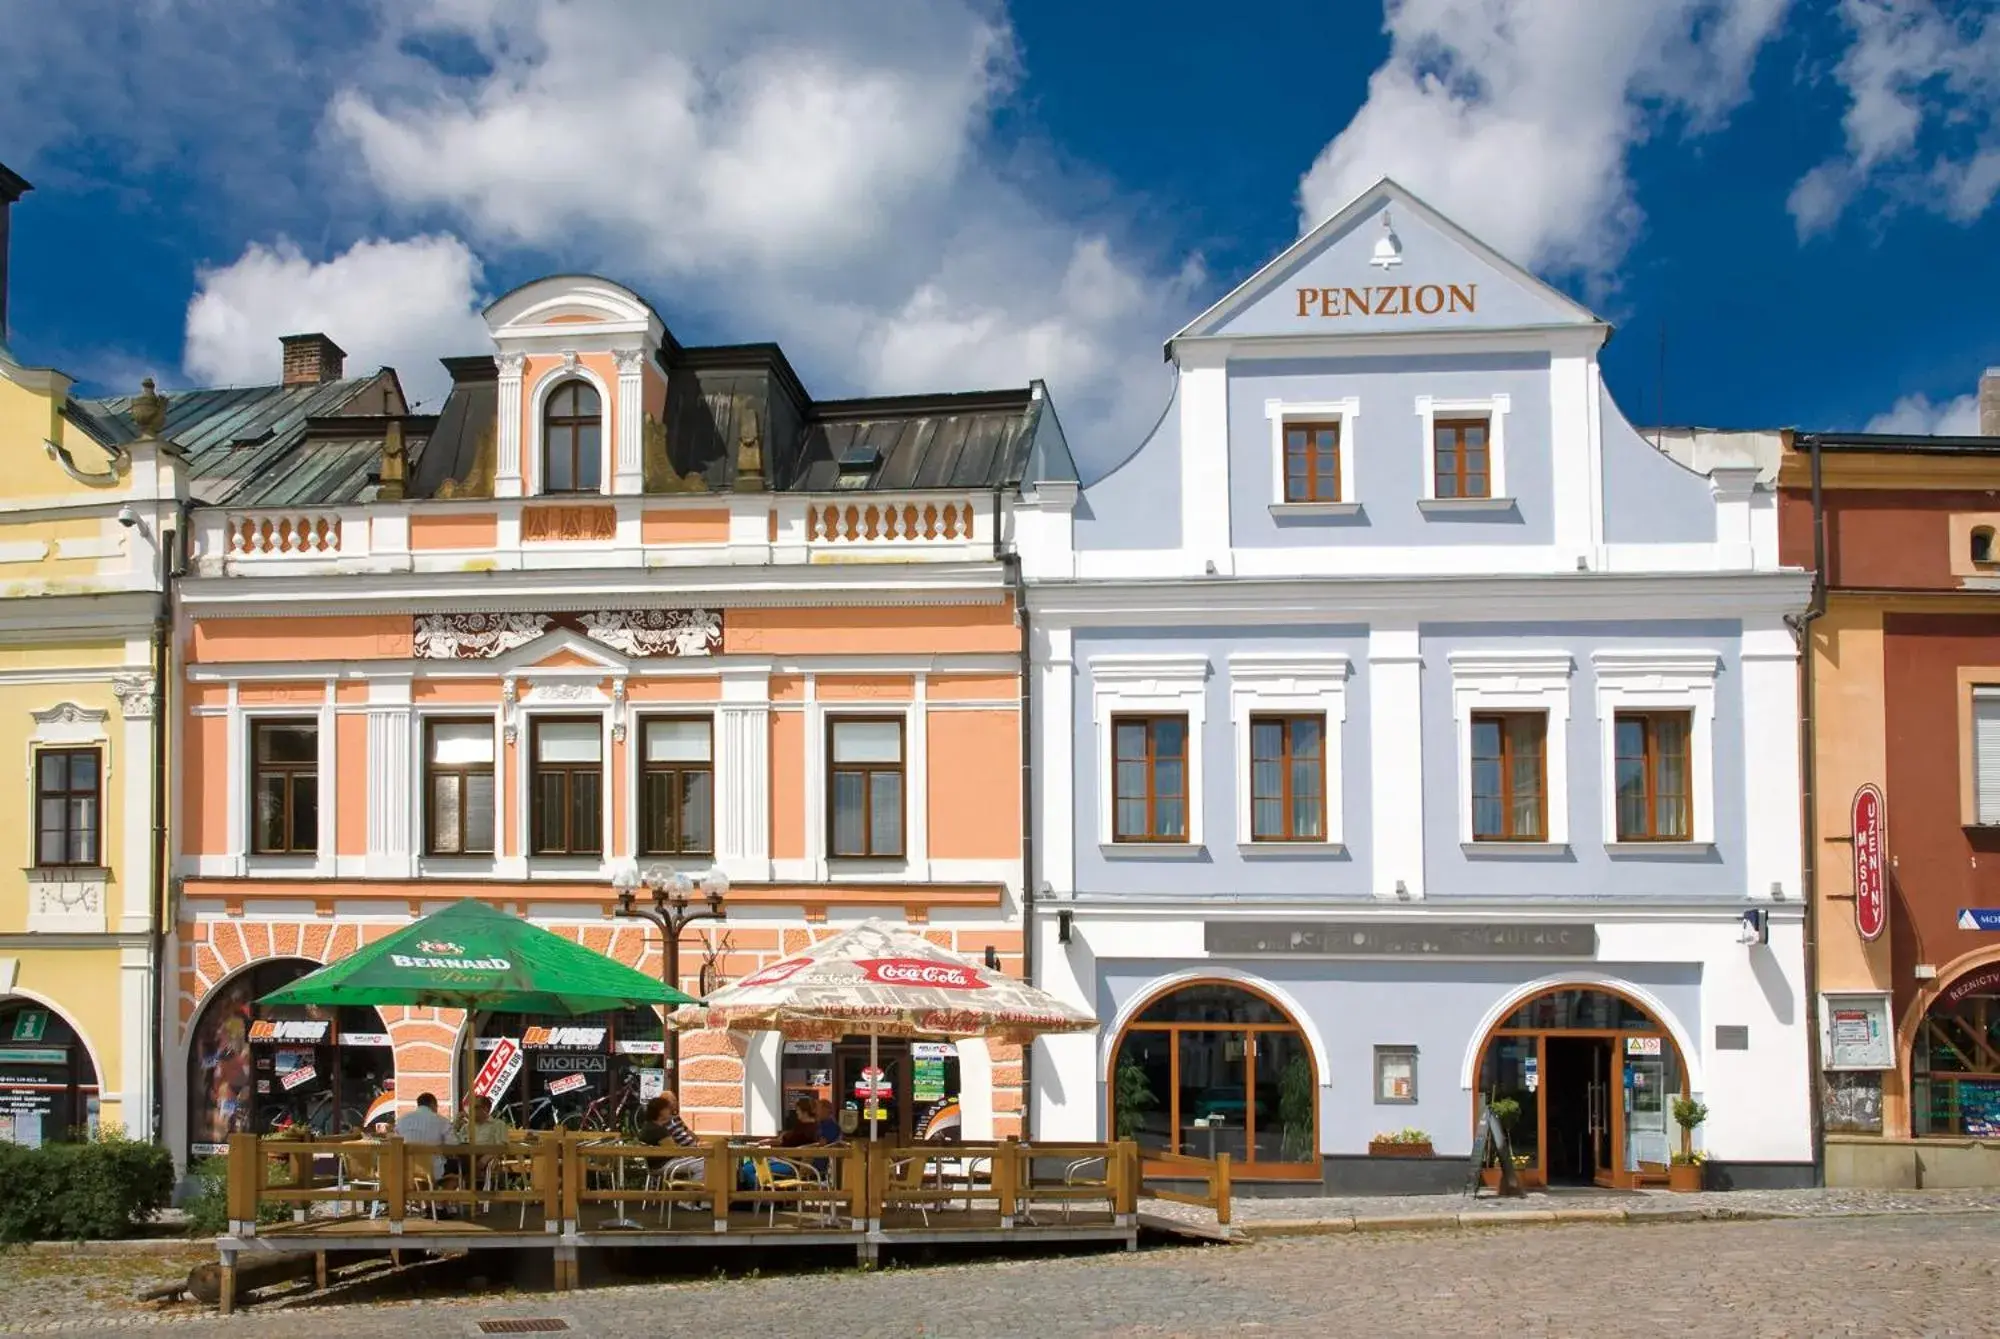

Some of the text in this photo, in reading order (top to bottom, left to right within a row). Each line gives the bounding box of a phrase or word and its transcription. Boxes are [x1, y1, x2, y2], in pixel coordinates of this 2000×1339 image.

[1296, 284, 1478, 317] PENZION
[1858, 832, 1869, 897] MASO
[1868, 802, 1880, 922] UZENINY
[1980, 915, 2000, 924] MO
[390, 954, 511, 970] BERNARD
[540, 1058, 602, 1070] MOIRA
